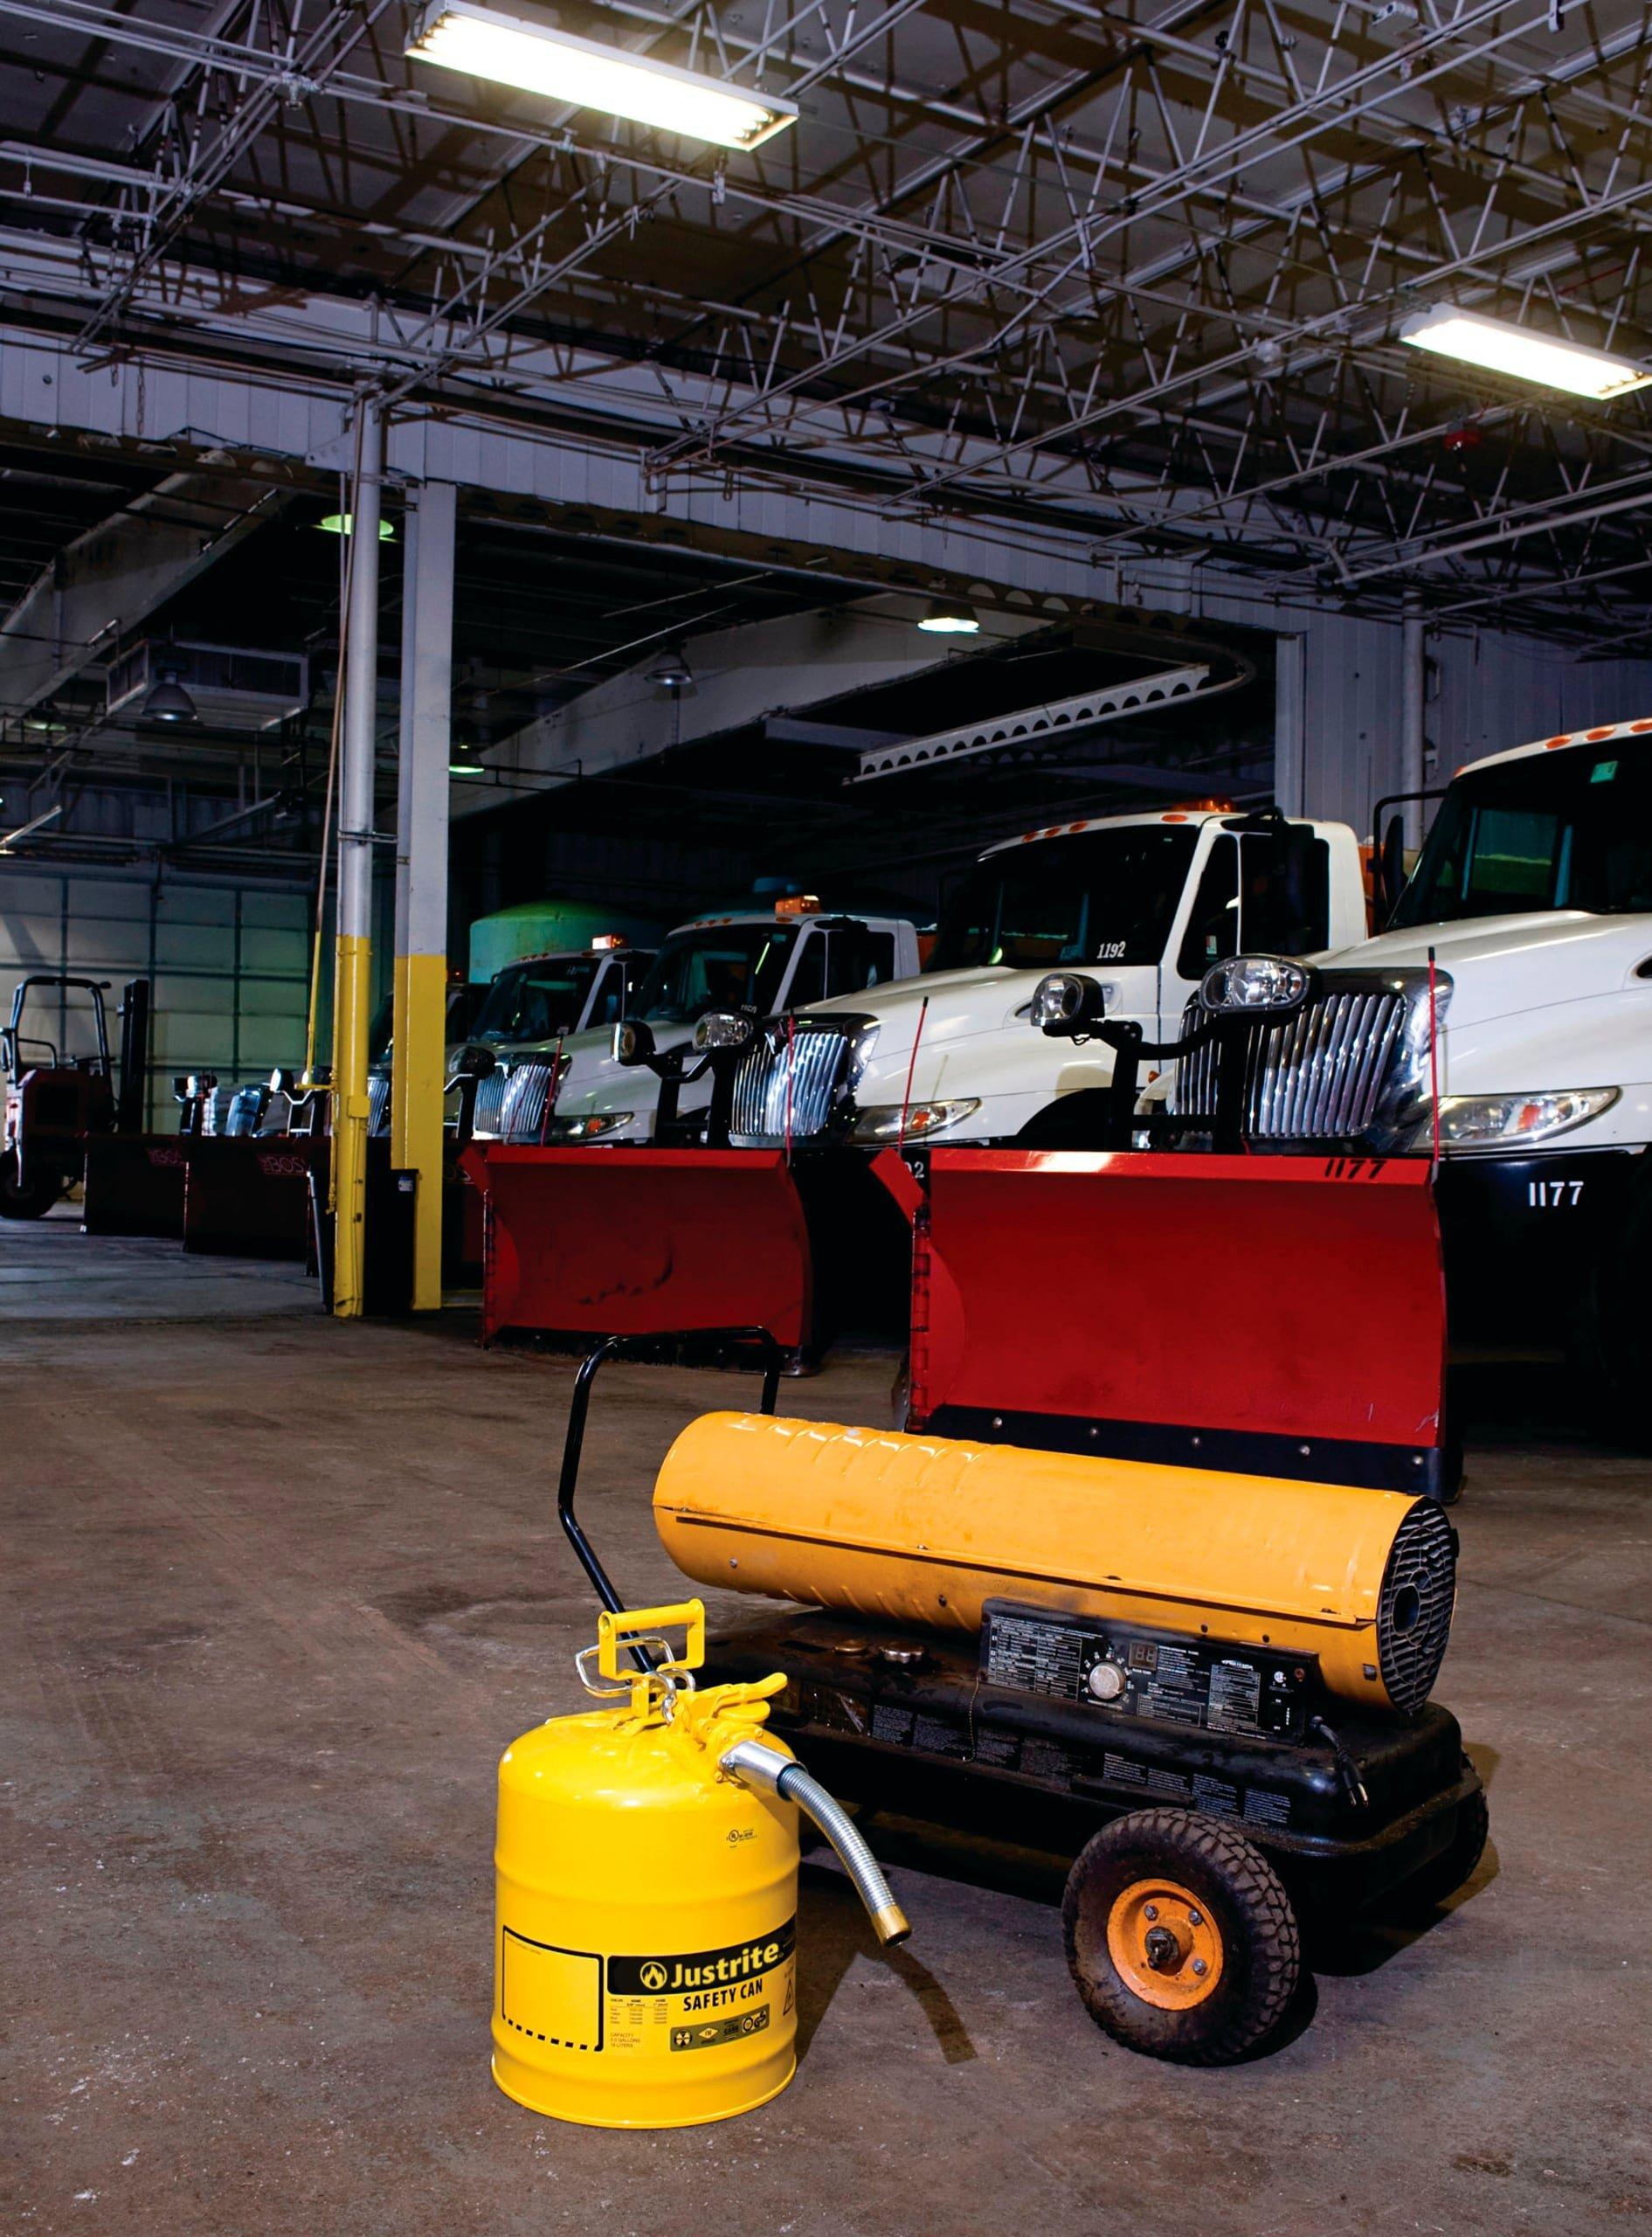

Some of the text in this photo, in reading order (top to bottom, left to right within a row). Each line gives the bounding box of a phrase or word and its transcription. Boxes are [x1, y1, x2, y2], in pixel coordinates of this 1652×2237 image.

[1097, 941, 1126, 959] 1192
[1324, 1159, 1386, 1179] 1177
[1530, 1181, 1584, 1207] 1177
[671, 1943, 779, 1988] Justrite
[684, 1988, 736, 2012] SAFETY
[741, 1978, 763, 1999] CAN
